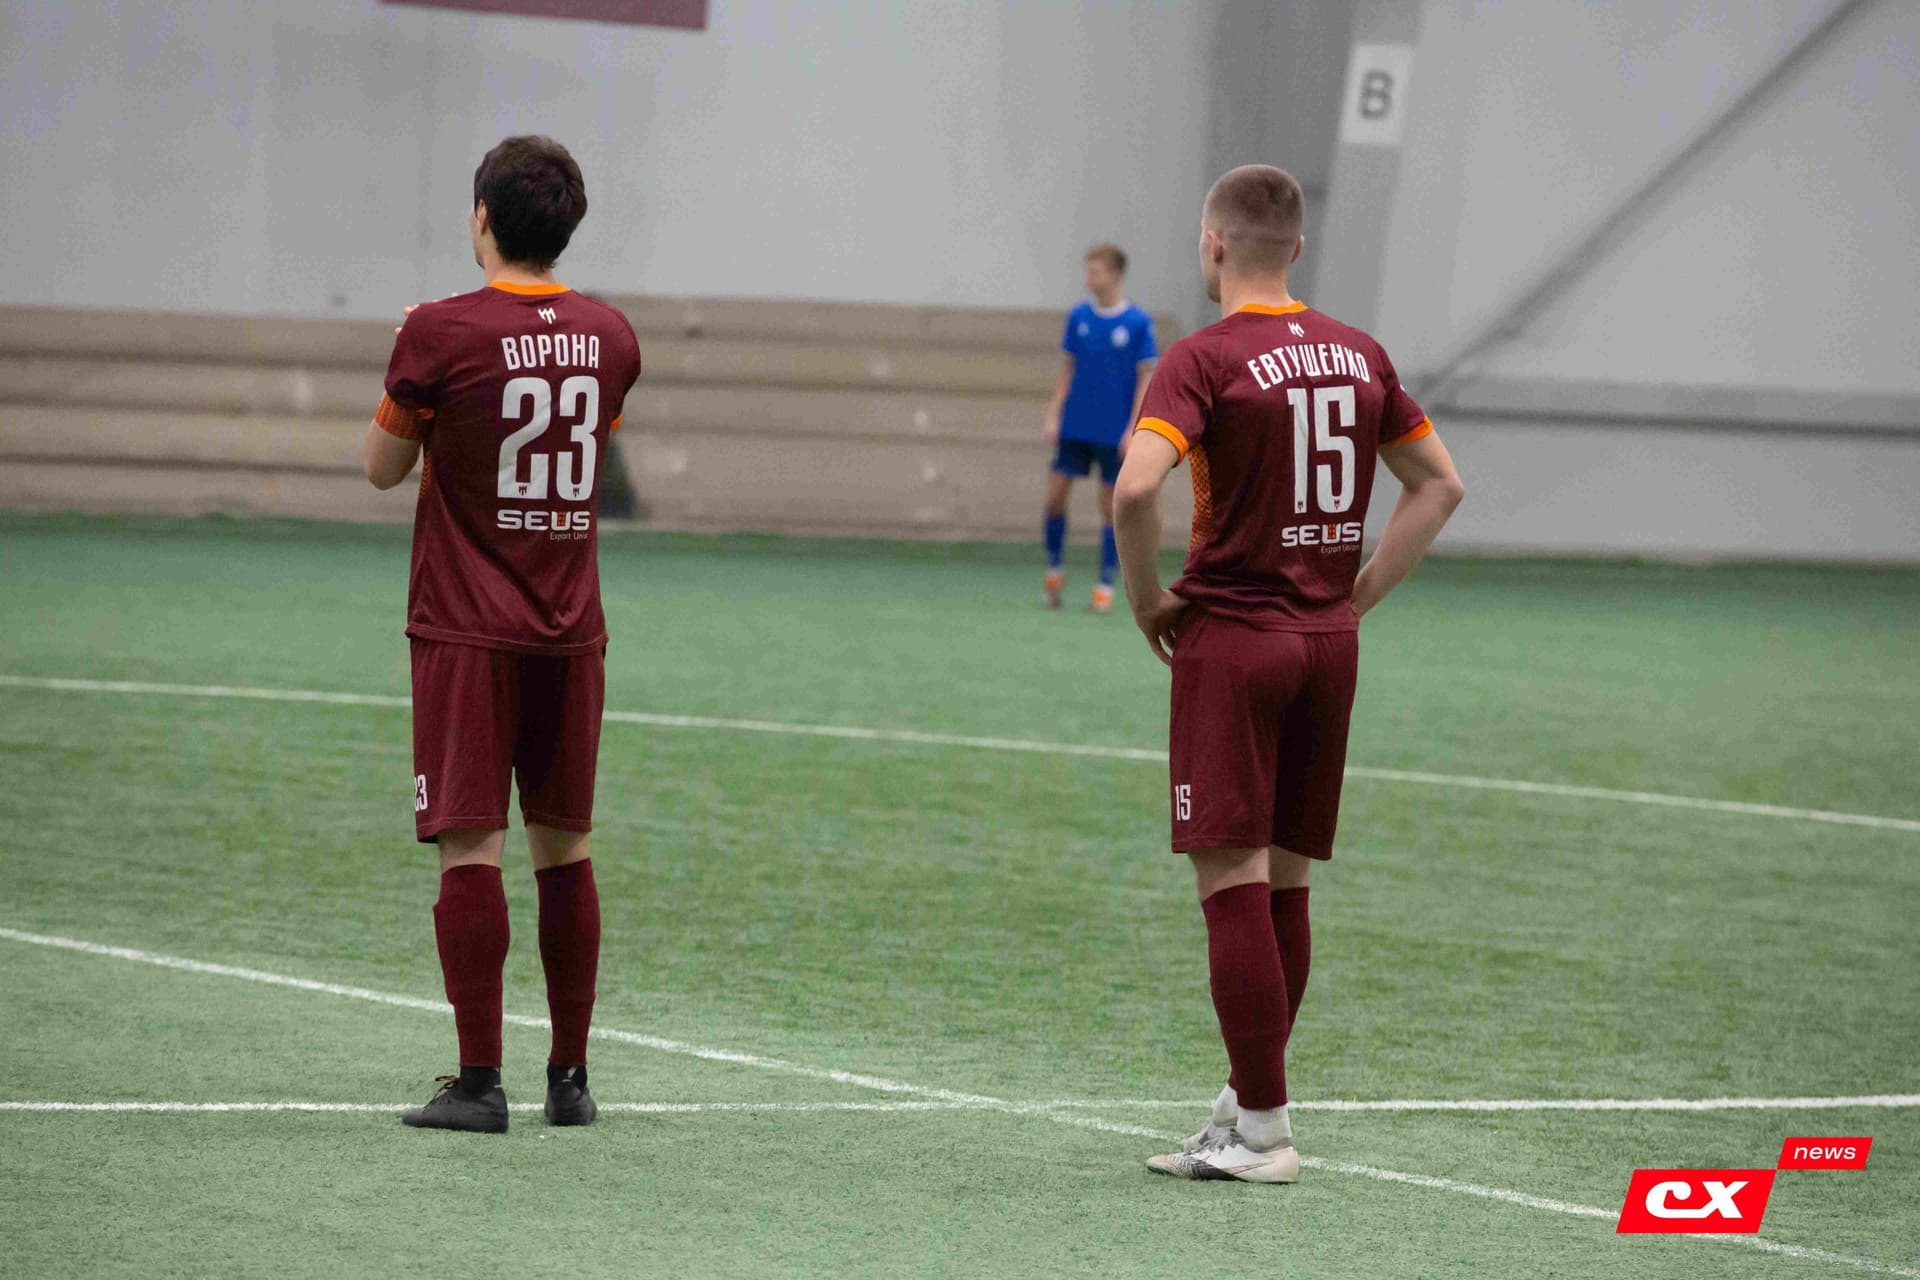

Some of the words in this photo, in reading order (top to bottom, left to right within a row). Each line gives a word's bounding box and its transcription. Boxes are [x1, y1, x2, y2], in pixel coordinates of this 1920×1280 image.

[501, 333, 599, 370] ВОРОНА
[1247, 343, 1370, 391] ЕВТУШЕНКО
[497, 375, 599, 501] 23
[1286, 385, 1356, 514] 15
[497, 509, 591, 531] SEUS
[1281, 521, 1362, 547] SEUS
[1175, 783, 1191, 821] 15
